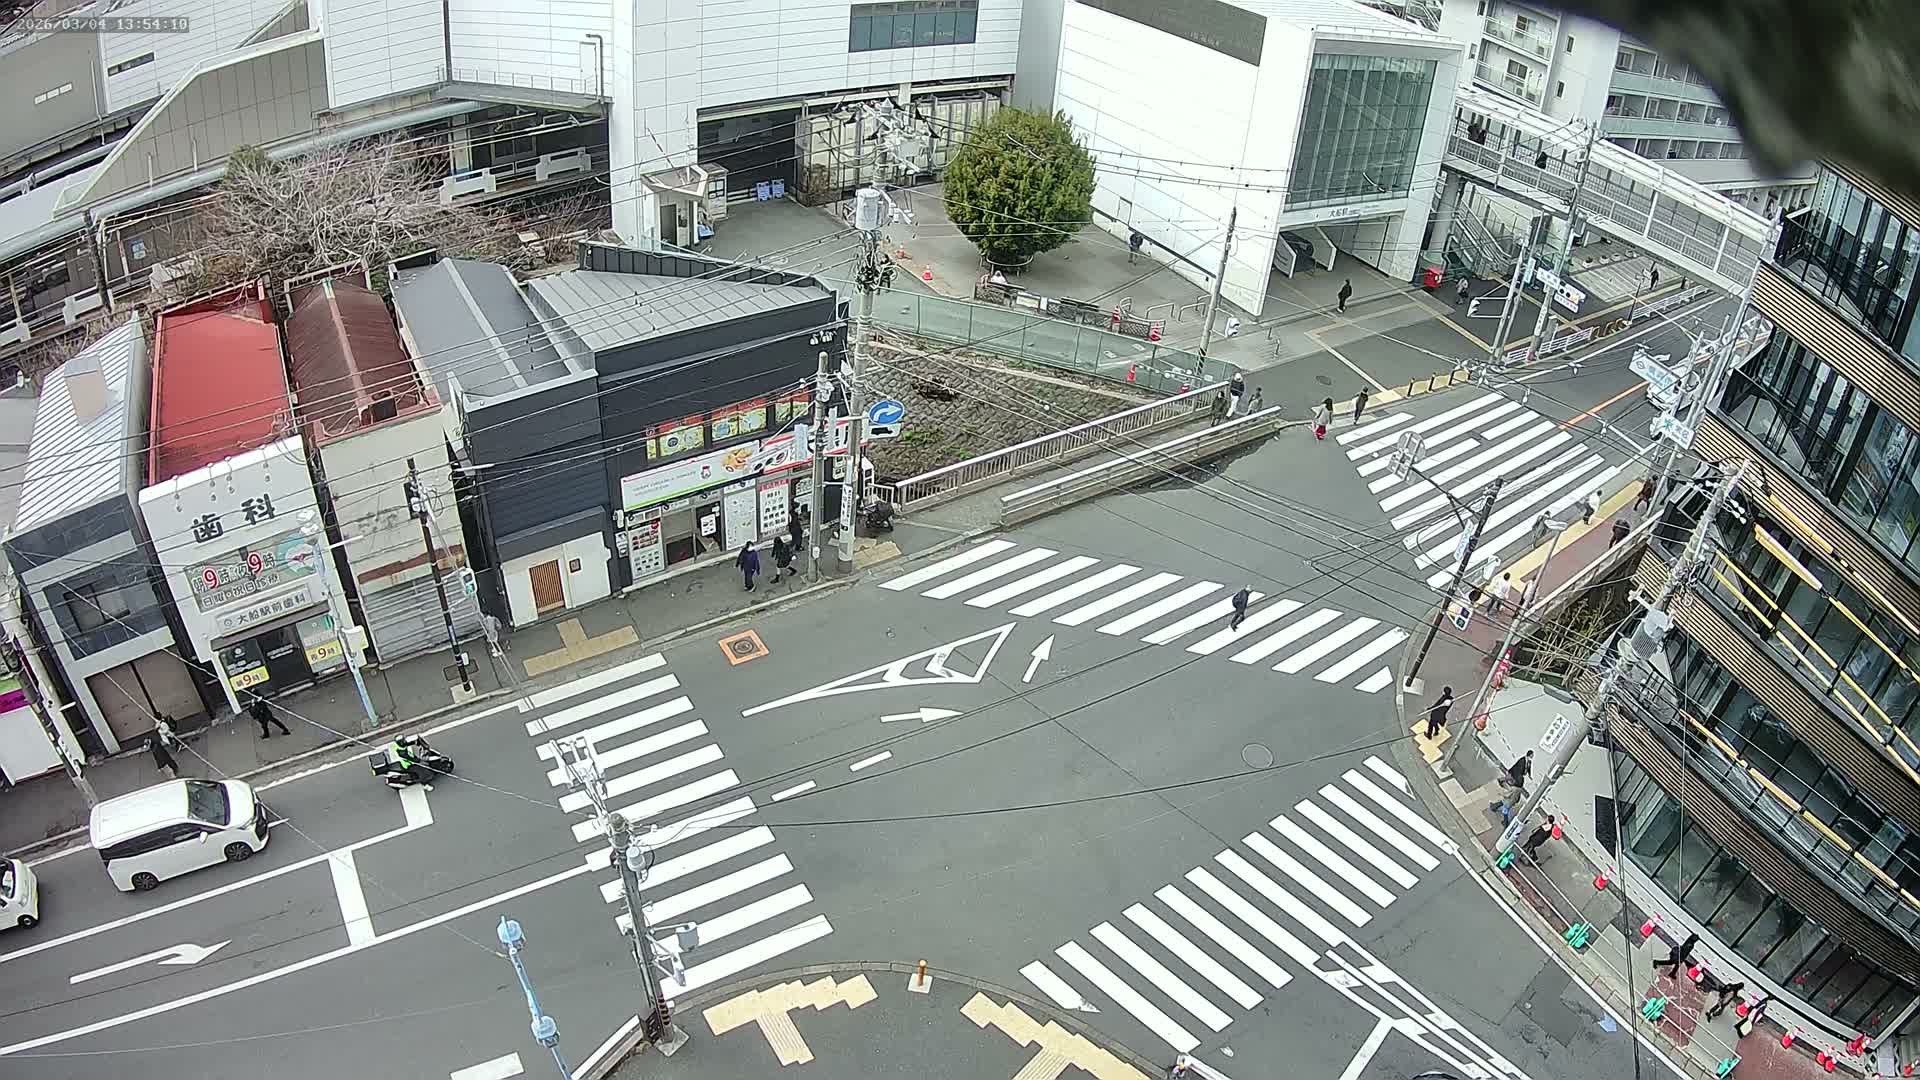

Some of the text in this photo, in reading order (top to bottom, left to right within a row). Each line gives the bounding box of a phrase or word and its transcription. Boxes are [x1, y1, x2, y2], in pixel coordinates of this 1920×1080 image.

[190, 493, 275, 543] 歯科
[237, 593, 306, 625] 大船駅前歯科
